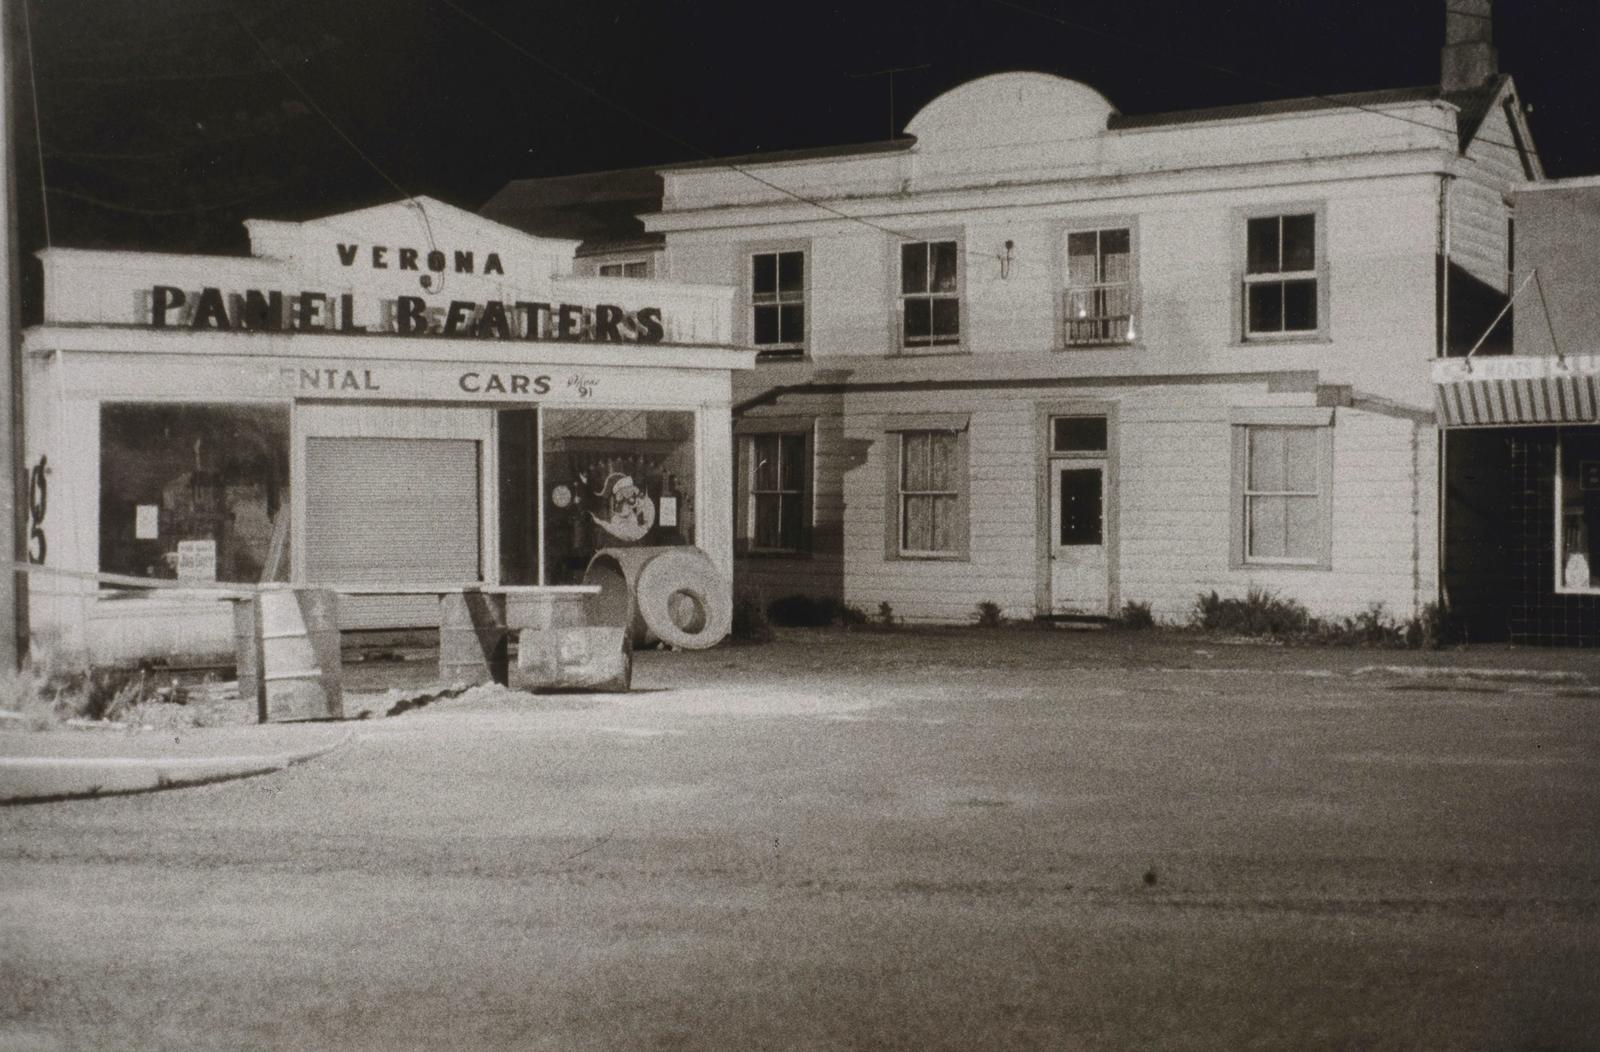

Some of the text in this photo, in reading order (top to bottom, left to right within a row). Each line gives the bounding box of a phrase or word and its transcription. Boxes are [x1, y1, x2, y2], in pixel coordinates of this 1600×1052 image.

[337, 243, 504, 275] VERONA
[152, 285, 665, 343] PANEL BEATERS
[458, 372, 552, 395] CARS
[578, 386, 593, 398] 91
